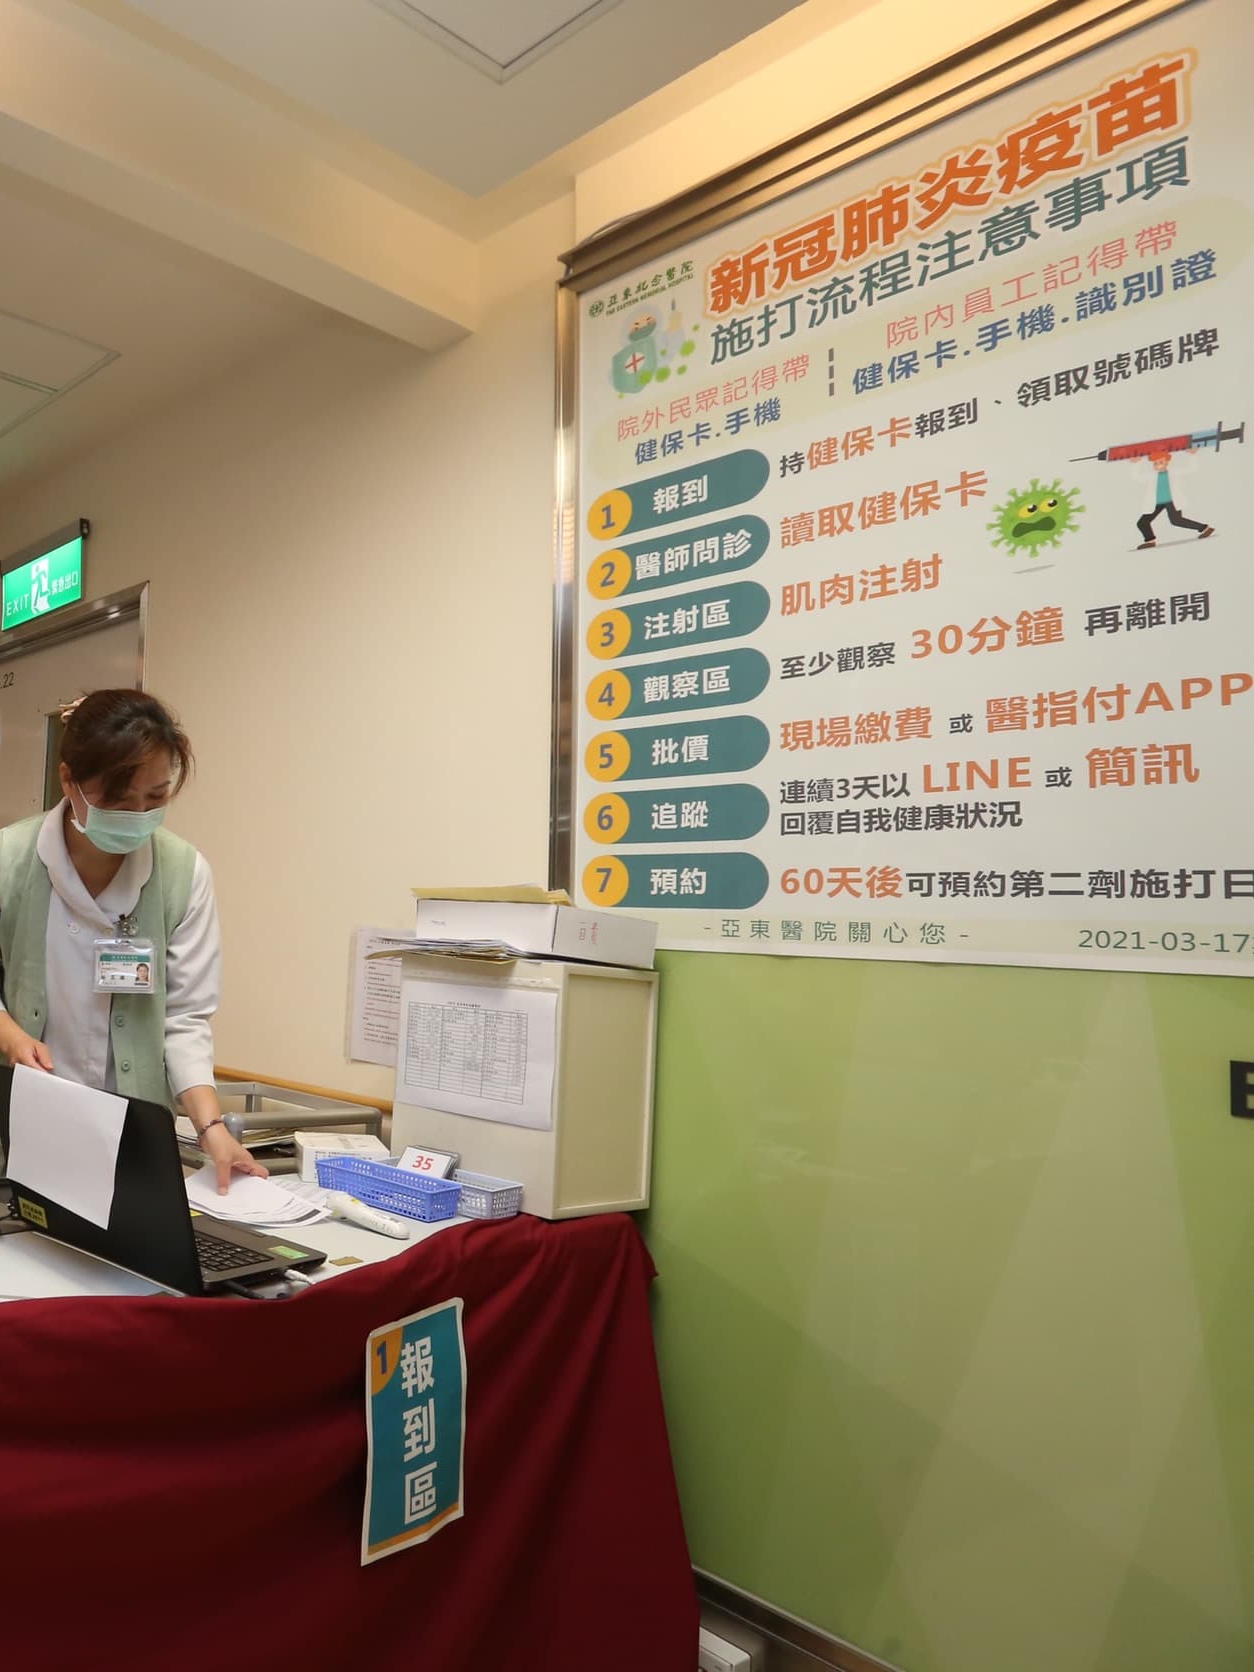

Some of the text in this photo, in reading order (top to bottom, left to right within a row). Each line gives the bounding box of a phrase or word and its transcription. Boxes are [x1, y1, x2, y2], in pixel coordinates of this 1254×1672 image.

[708, 56, 1188, 315] 新冠肺炎疫苗
[710, 136, 1190, 366] 施打流程注意事項
[886, 219, 1178, 349] 院內員工記得帶
[617, 353, 811, 442] 院外民眾記得帶
[601, 475, 709, 530] 1 報到
[779, 470, 990, 551] 讀取健保卡
[600, 528, 753, 588] 2 醫師問診
[779, 554, 944, 617] 肌肉注射
[6, 593, 30, 617] EXIT
[600, 598, 731, 648] 3 注射區
[779, 592, 1211, 681] 至少觀察 30分鐘 再離開
[598, 664, 731, 707] 4 觀察區
[599, 734, 710, 770] 5 批價
[779, 706, 933, 752] 現場繳費
[948, 712, 974, 736] 或
[779, 743, 1201, 805] 連續3天以 LINE 或 簡訊
[597, 800, 709, 831] 6 追蹤
[779, 801, 1023, 837] 回覆自我健康狀況
[596, 867, 707, 896] 7 預約
[1078, 929, 1254, 954] 2021-03-17
[412, 1155, 434, 1171] 35
[376, 1336, 438, 1525] 1 報到區
